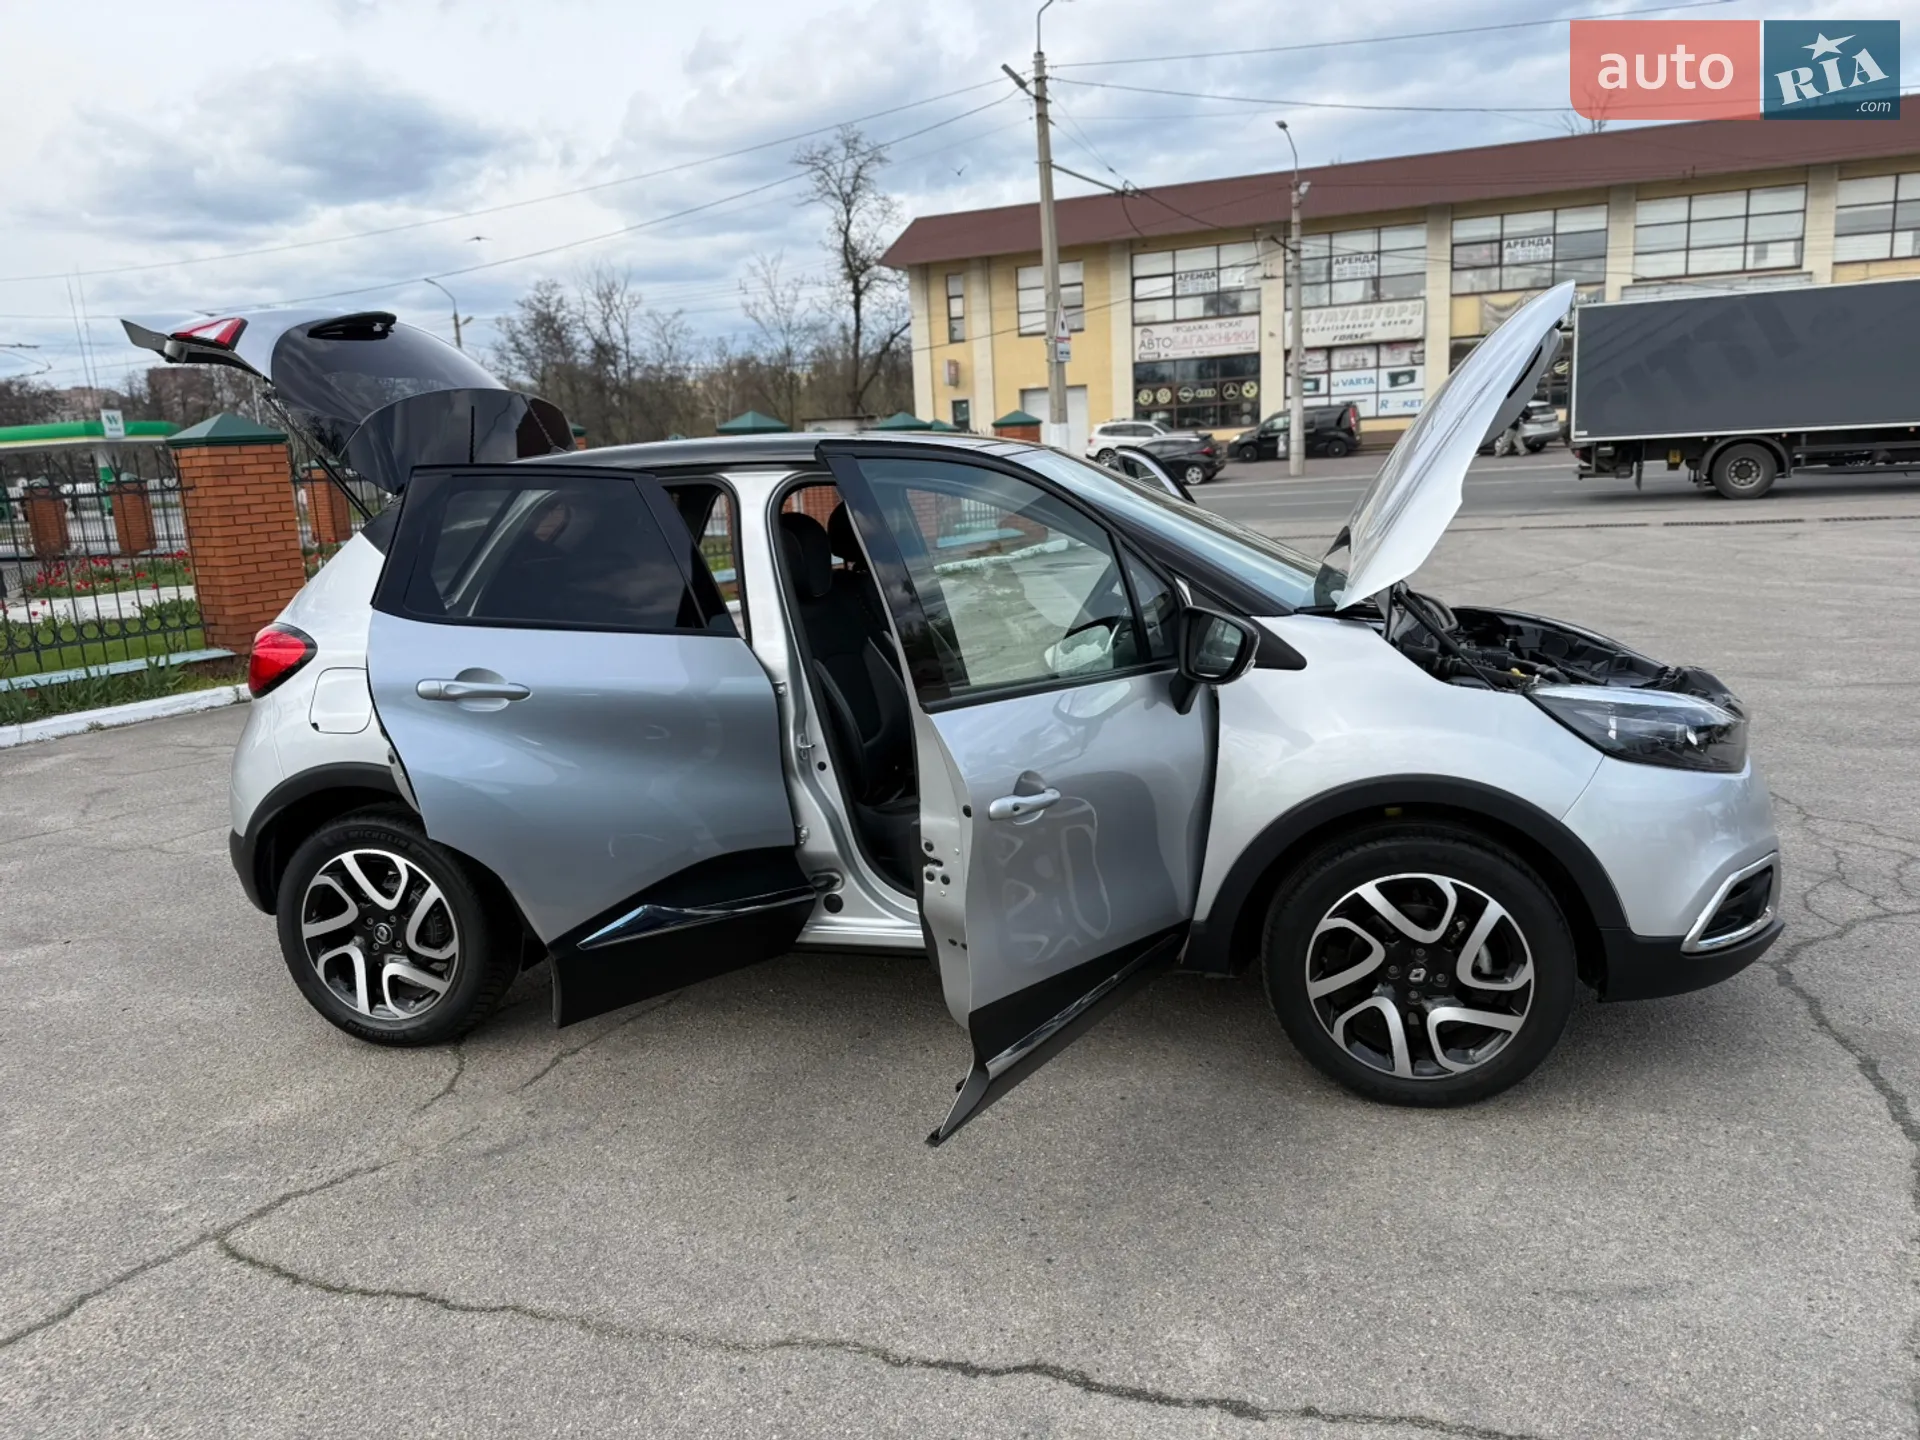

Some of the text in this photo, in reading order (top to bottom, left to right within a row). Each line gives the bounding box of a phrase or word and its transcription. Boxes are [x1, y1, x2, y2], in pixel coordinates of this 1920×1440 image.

[1505, 237, 1552, 249] АРЕНДА
[1334, 254, 1377, 265] АРЕНДА
[1177, 270, 1217, 282] АРЕНДА
[1172, 323, 1209, 333] ПРОДАЖА
[1215, 319, 1243, 330] ПРОКАТ
[1341, 377, 1375, 387] VARTA
